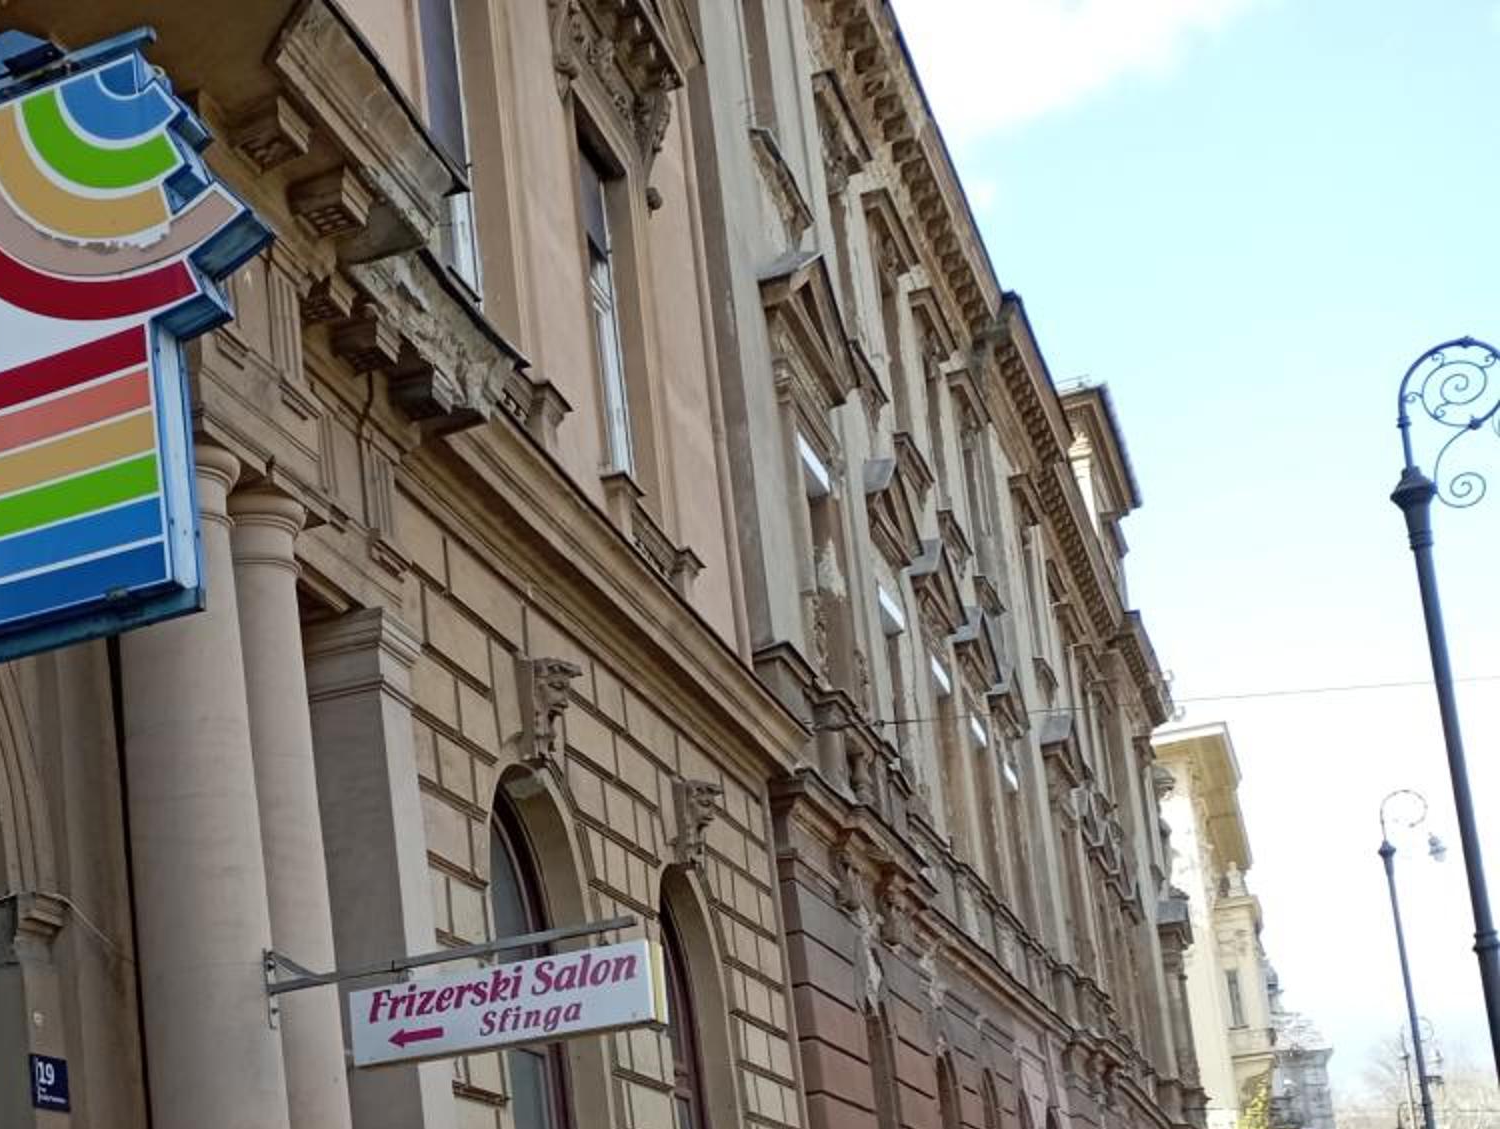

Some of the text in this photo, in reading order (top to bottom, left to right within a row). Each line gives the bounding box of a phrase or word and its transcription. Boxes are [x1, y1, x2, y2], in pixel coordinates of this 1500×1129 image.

[369, 953, 637, 1024] Frizerski Salon
[480, 1002, 582, 1036] Sfinga
